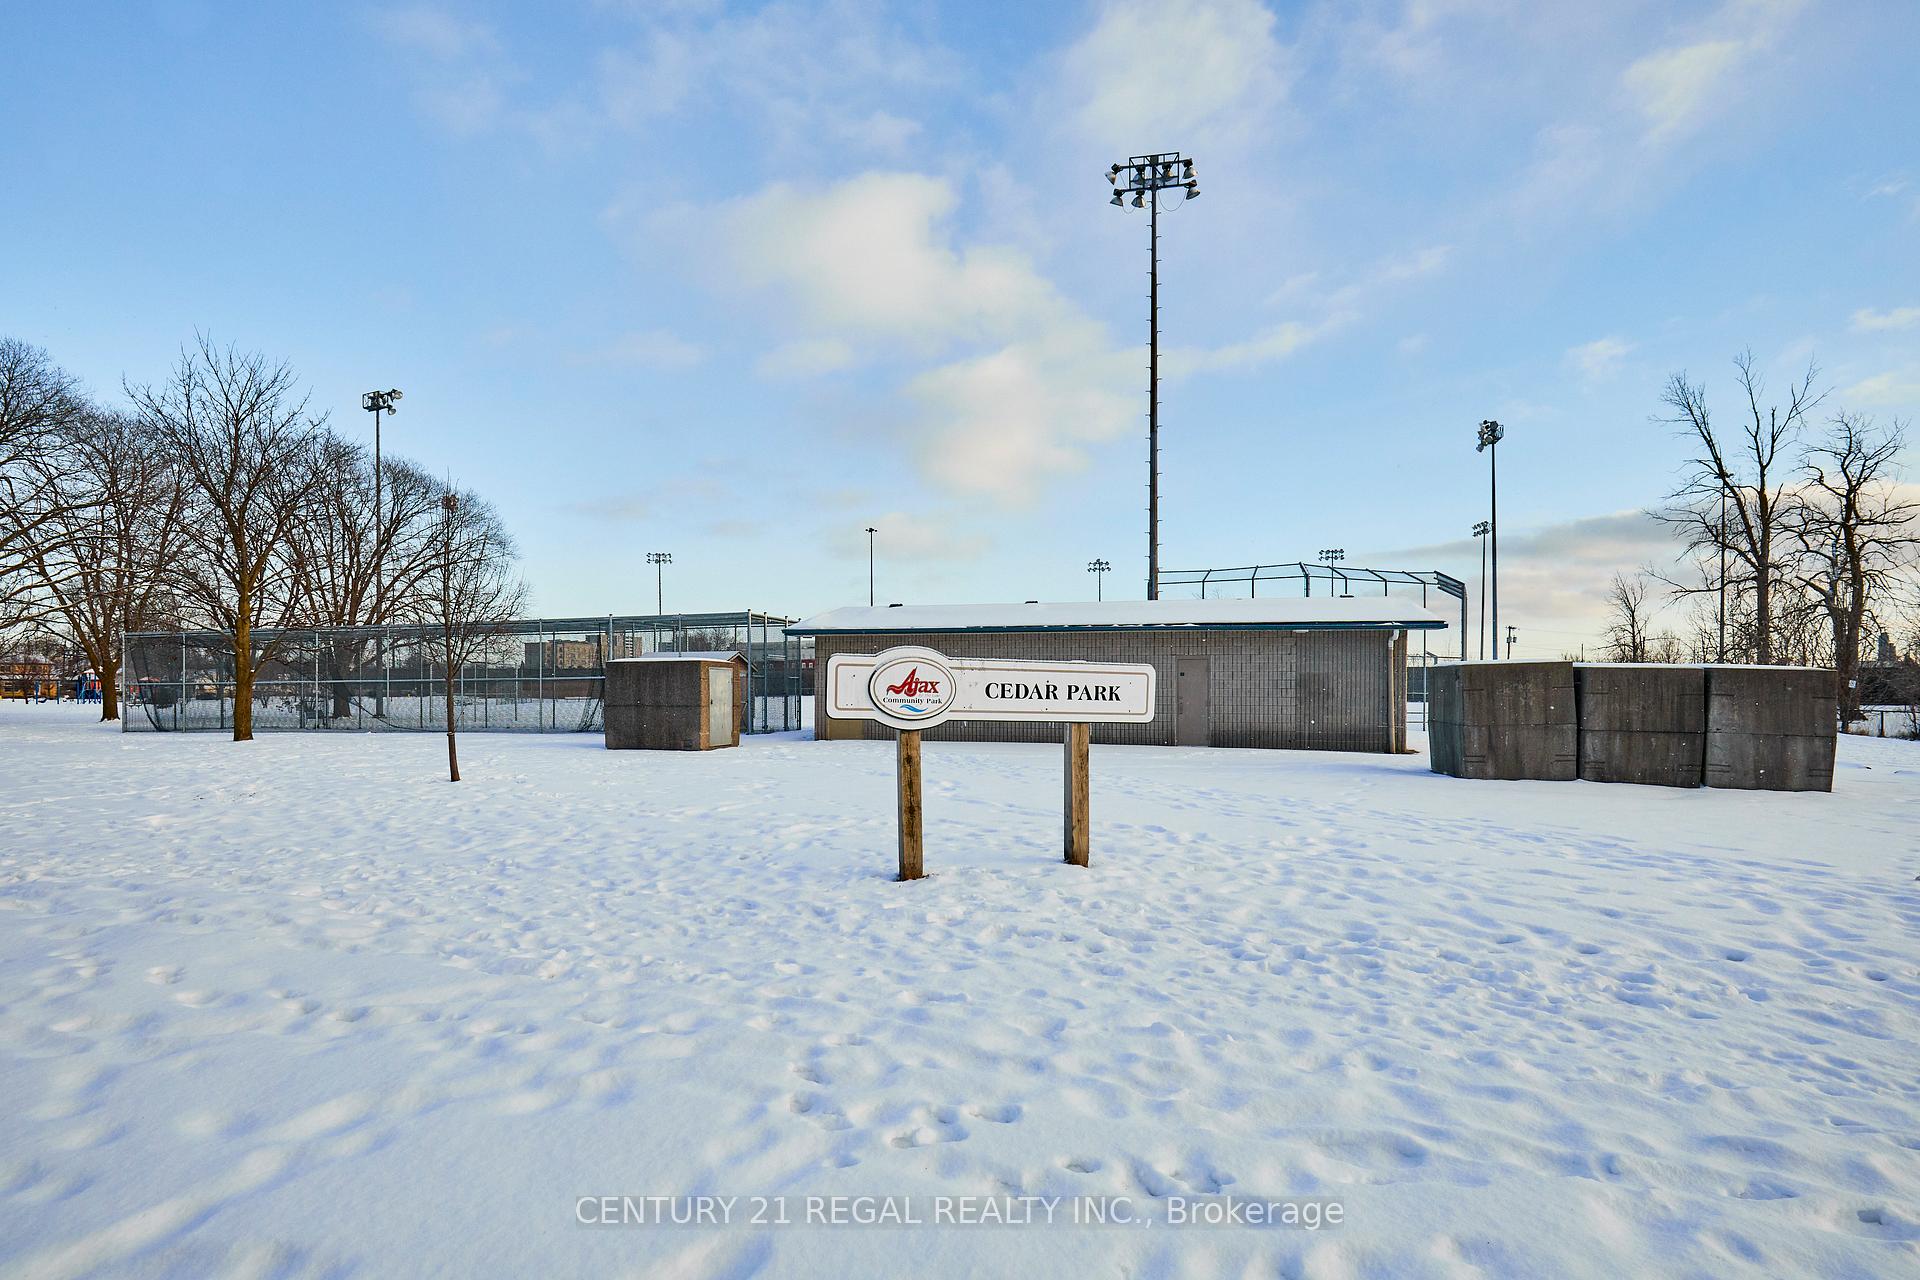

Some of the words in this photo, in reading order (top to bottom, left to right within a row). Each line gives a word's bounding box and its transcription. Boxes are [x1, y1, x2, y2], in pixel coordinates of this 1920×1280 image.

[886, 666, 940, 697] Ajax
[883, 697, 923, 705] Community
[985, 682, 1058, 700] CEDAR
[1067, 684, 1121, 701] PARK
